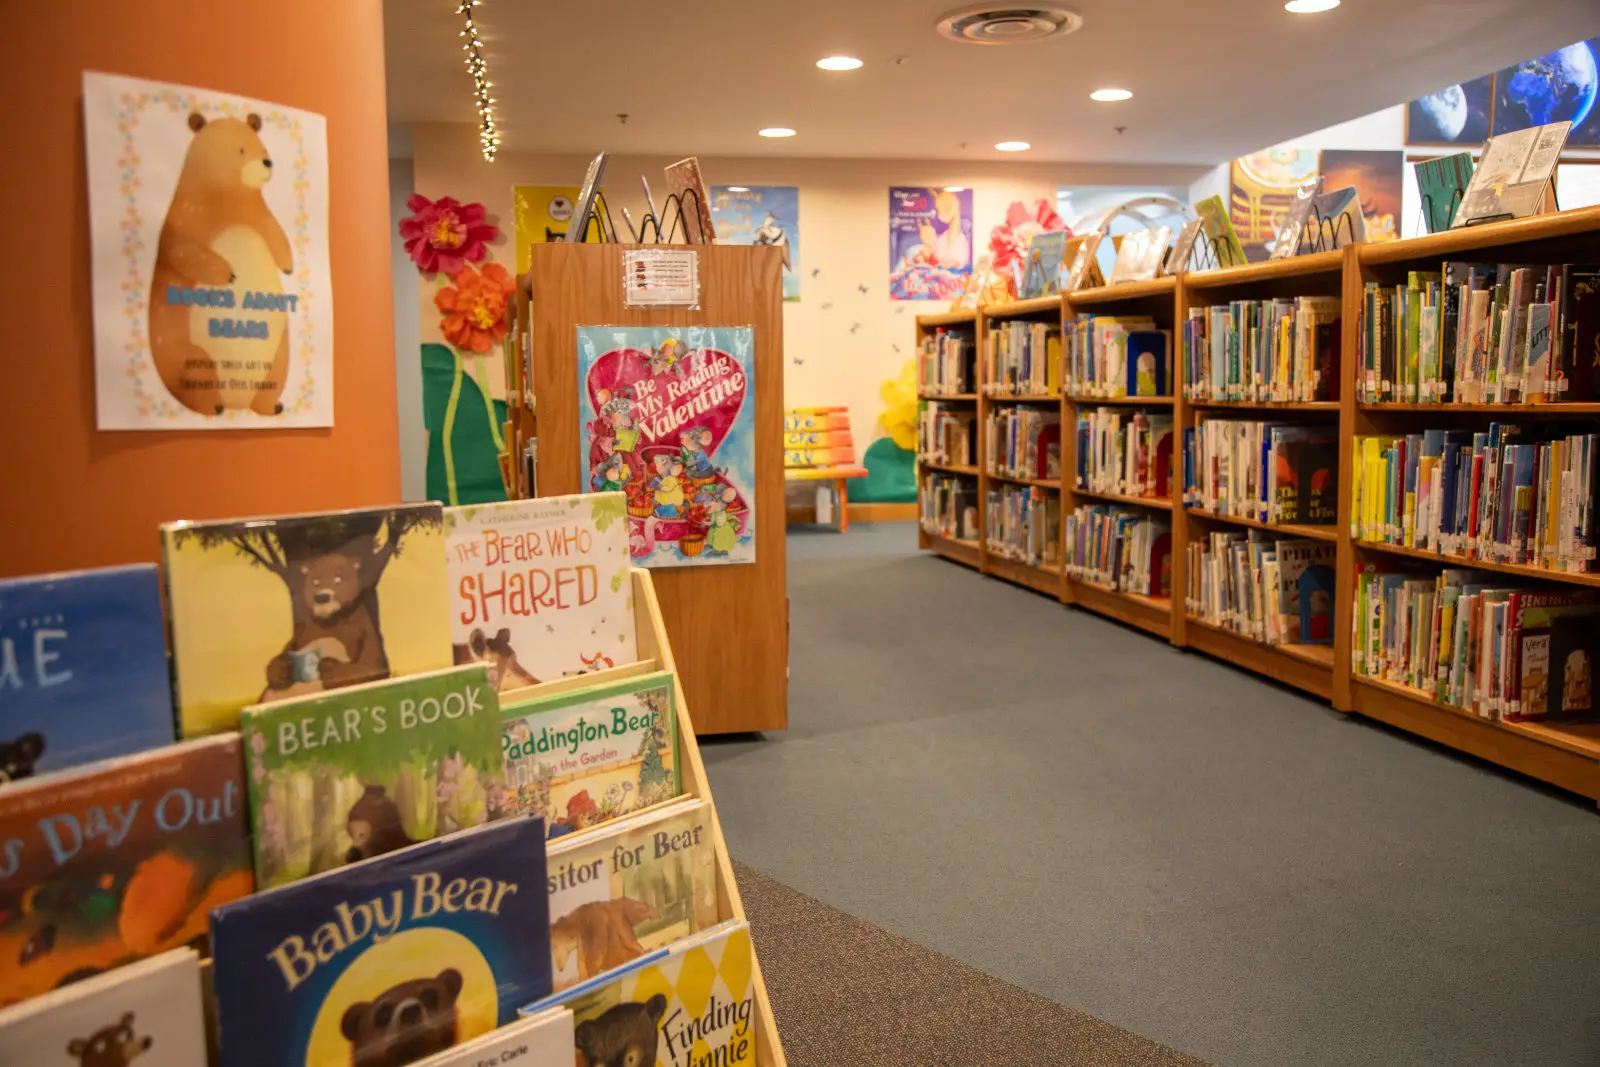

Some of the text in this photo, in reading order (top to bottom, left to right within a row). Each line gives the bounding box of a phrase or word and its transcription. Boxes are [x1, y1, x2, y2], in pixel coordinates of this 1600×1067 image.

[242, 290, 299, 313] ABOUT
[209, 318, 269, 339] BEARS
[633, 378, 657, 400] Be
[637, 356, 731, 420] My Reading
[639, 371, 745, 443] Valentine
[455, 541, 481, 563] THE
[545, 525, 593, 557] WHO
[1283, 546, 1336, 561] PIRAT
[278, 685, 484, 755] BEAR'S BOOK
[501, 707, 659, 760] Paddington Bear
[560, 757, 578, 771] the
[580, 749, 618, 766] Garden
[38, 798, 142, 867] Day
[153, 779, 239, 832] Out
[611, 845, 645, 874] for
[653, 824, 703, 860] Bear
[266, 872, 518, 992] Baby Bear
[662, 995, 752, 1060] Finding
[501, 1045, 528, 1063] Carle
